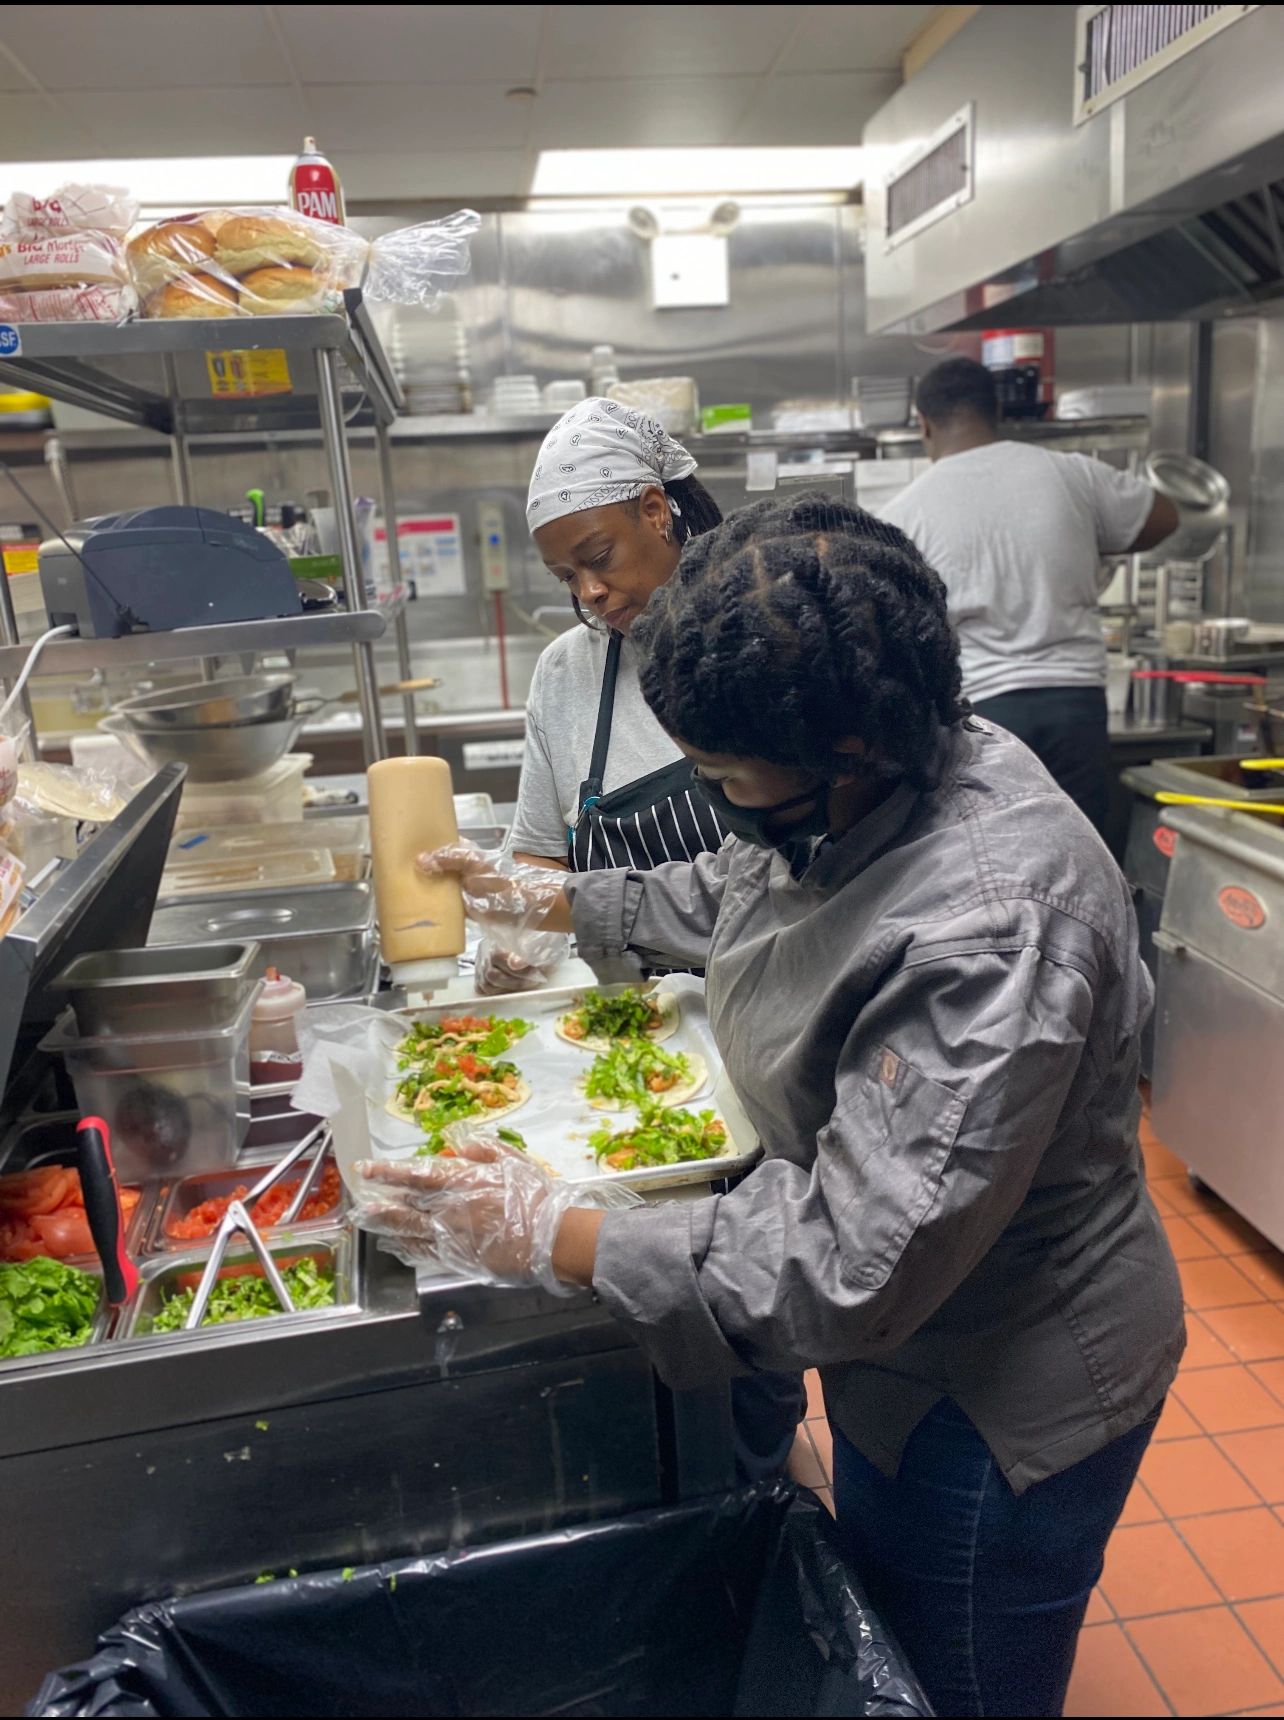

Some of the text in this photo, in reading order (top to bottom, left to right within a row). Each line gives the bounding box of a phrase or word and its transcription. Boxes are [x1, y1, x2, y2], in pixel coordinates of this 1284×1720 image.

[297, 191, 337, 218] PAM
[24, 253, 80, 265] LARGE ROLLS
[0, 331, 17, 347] SF
